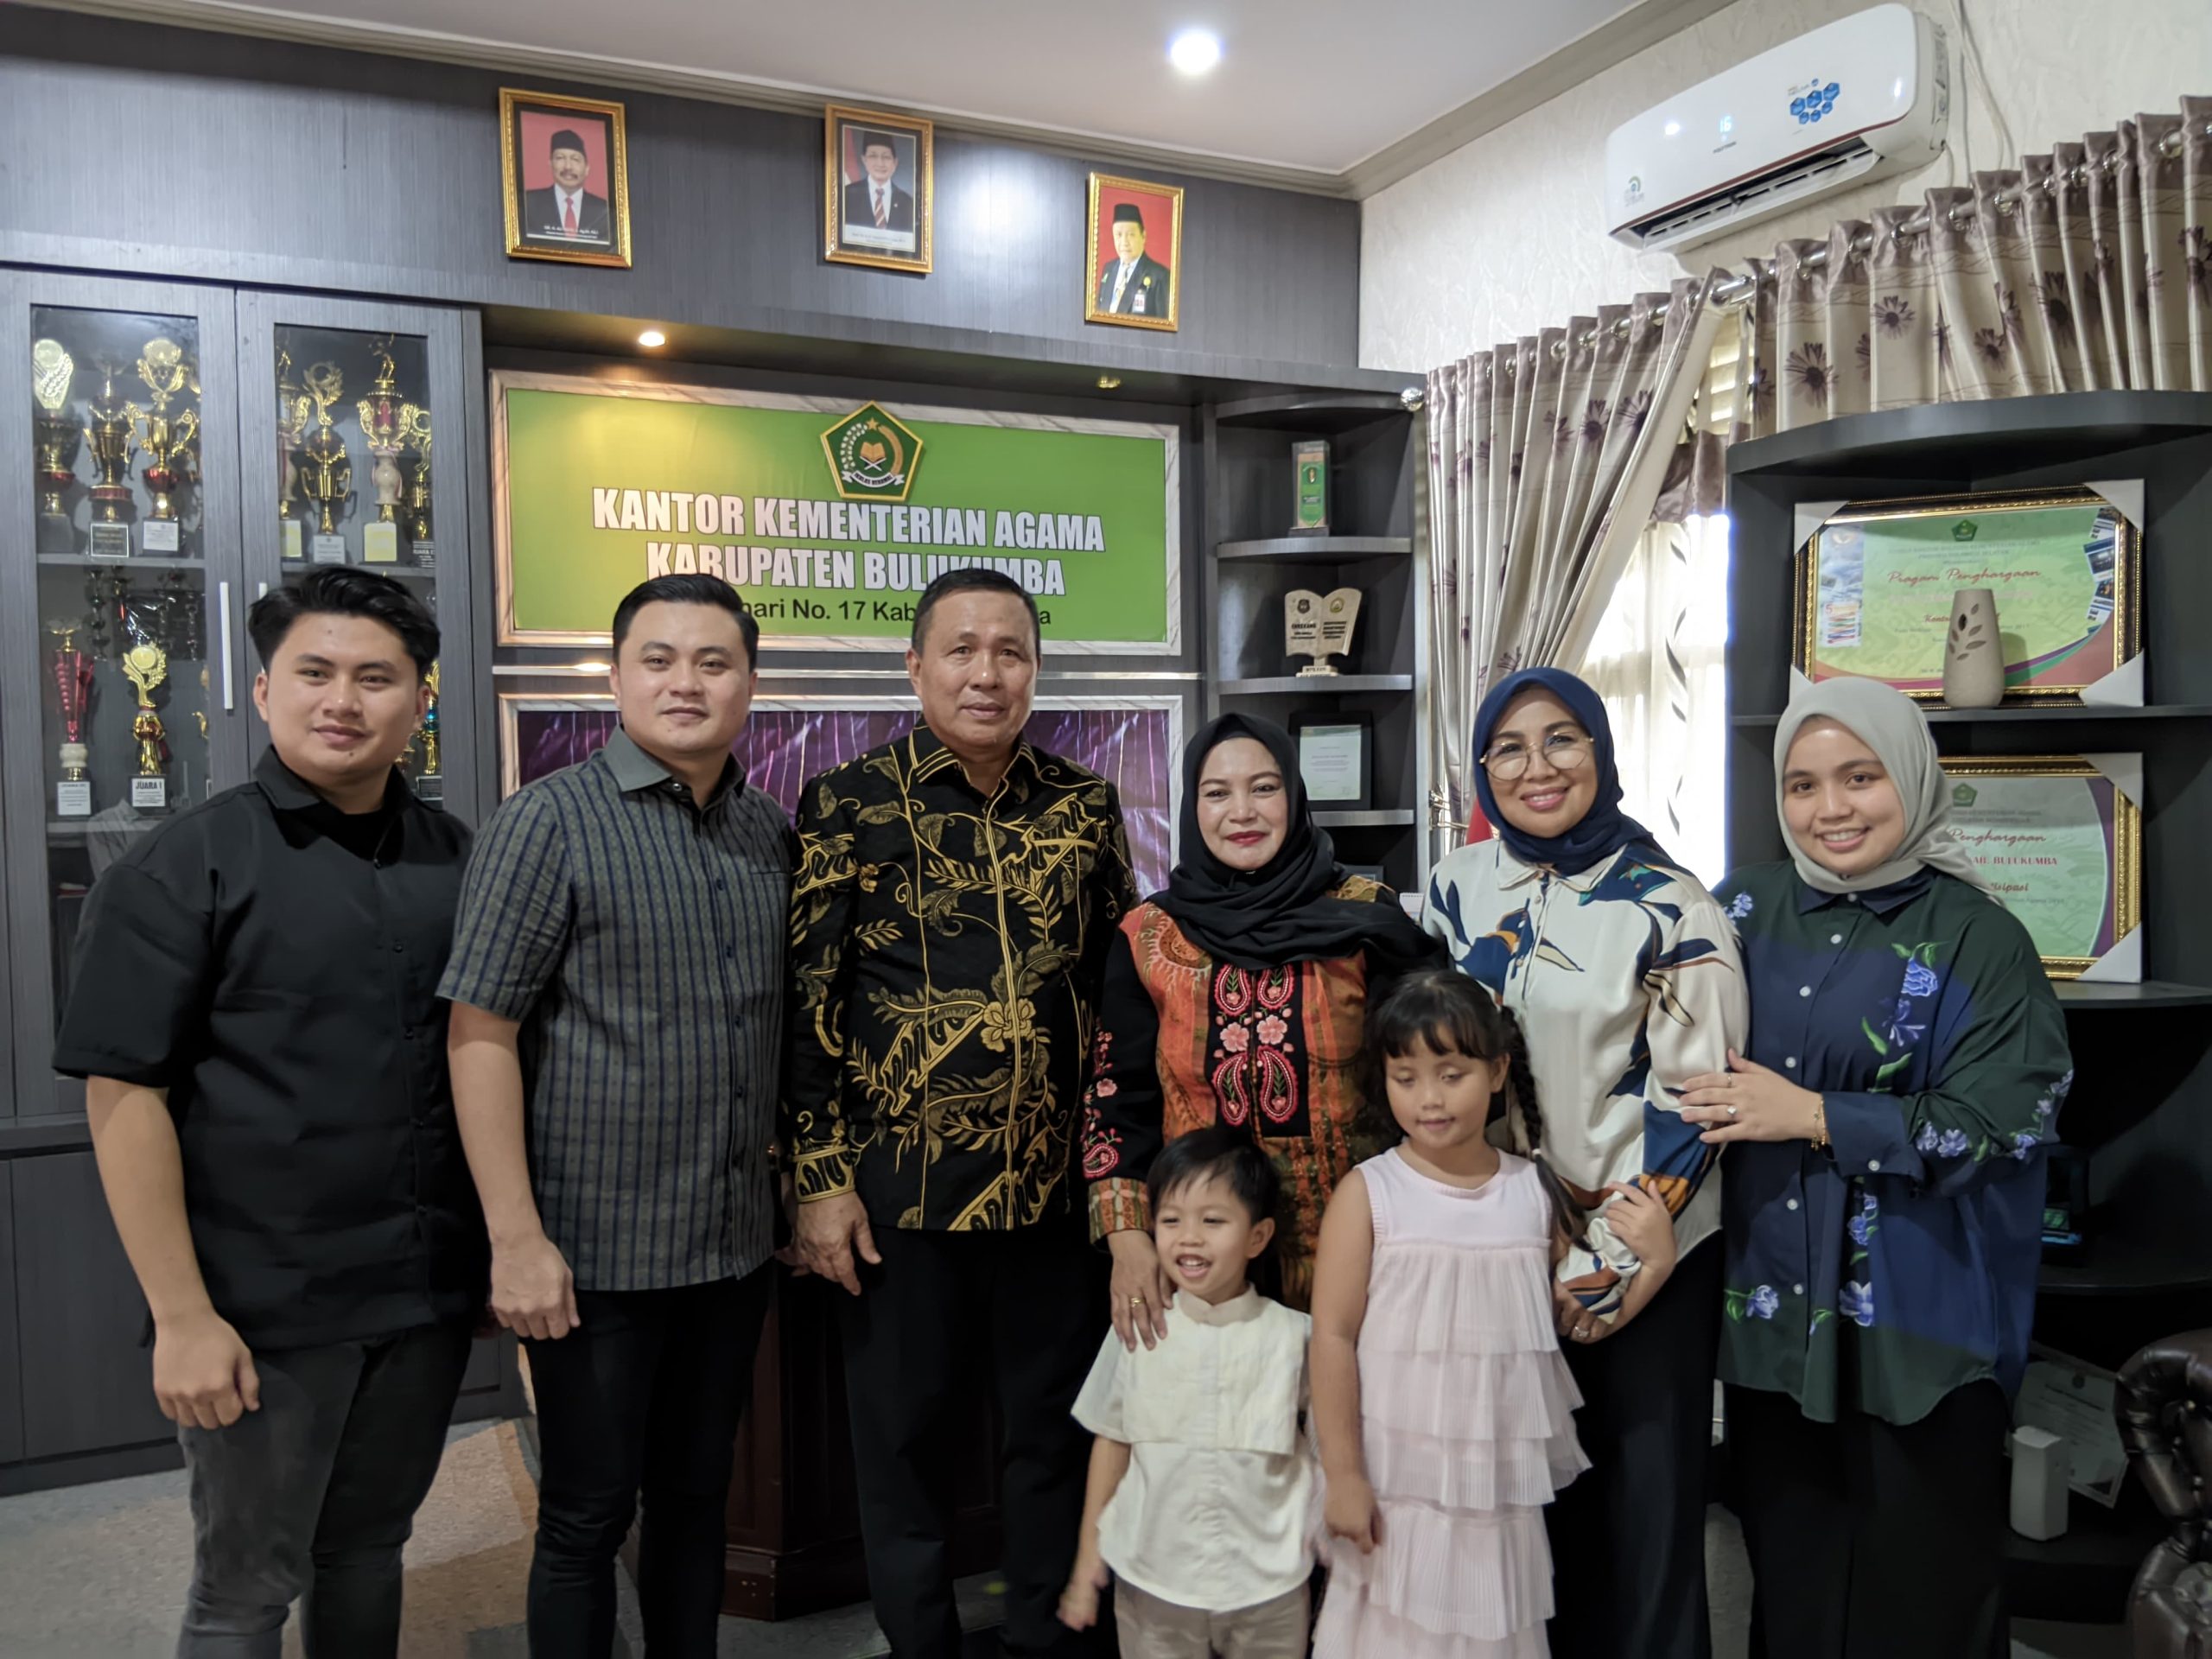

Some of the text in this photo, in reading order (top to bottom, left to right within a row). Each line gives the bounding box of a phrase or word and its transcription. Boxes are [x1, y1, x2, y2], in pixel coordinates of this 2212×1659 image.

[593, 487, 1106, 552] KANTOR KEMENTERIAN AGAMA
[646, 542, 855, 589] KABUPATEN
[1947, 567, 2042, 584] Penghargaan
[792, 599, 830, 620] No.
[838, 601, 866, 620] 17
[136, 781, 157, 790] JUARA
[1949, 828, 2046, 847] Penghargaan
[1991, 882, 2030, 893] isipasi
